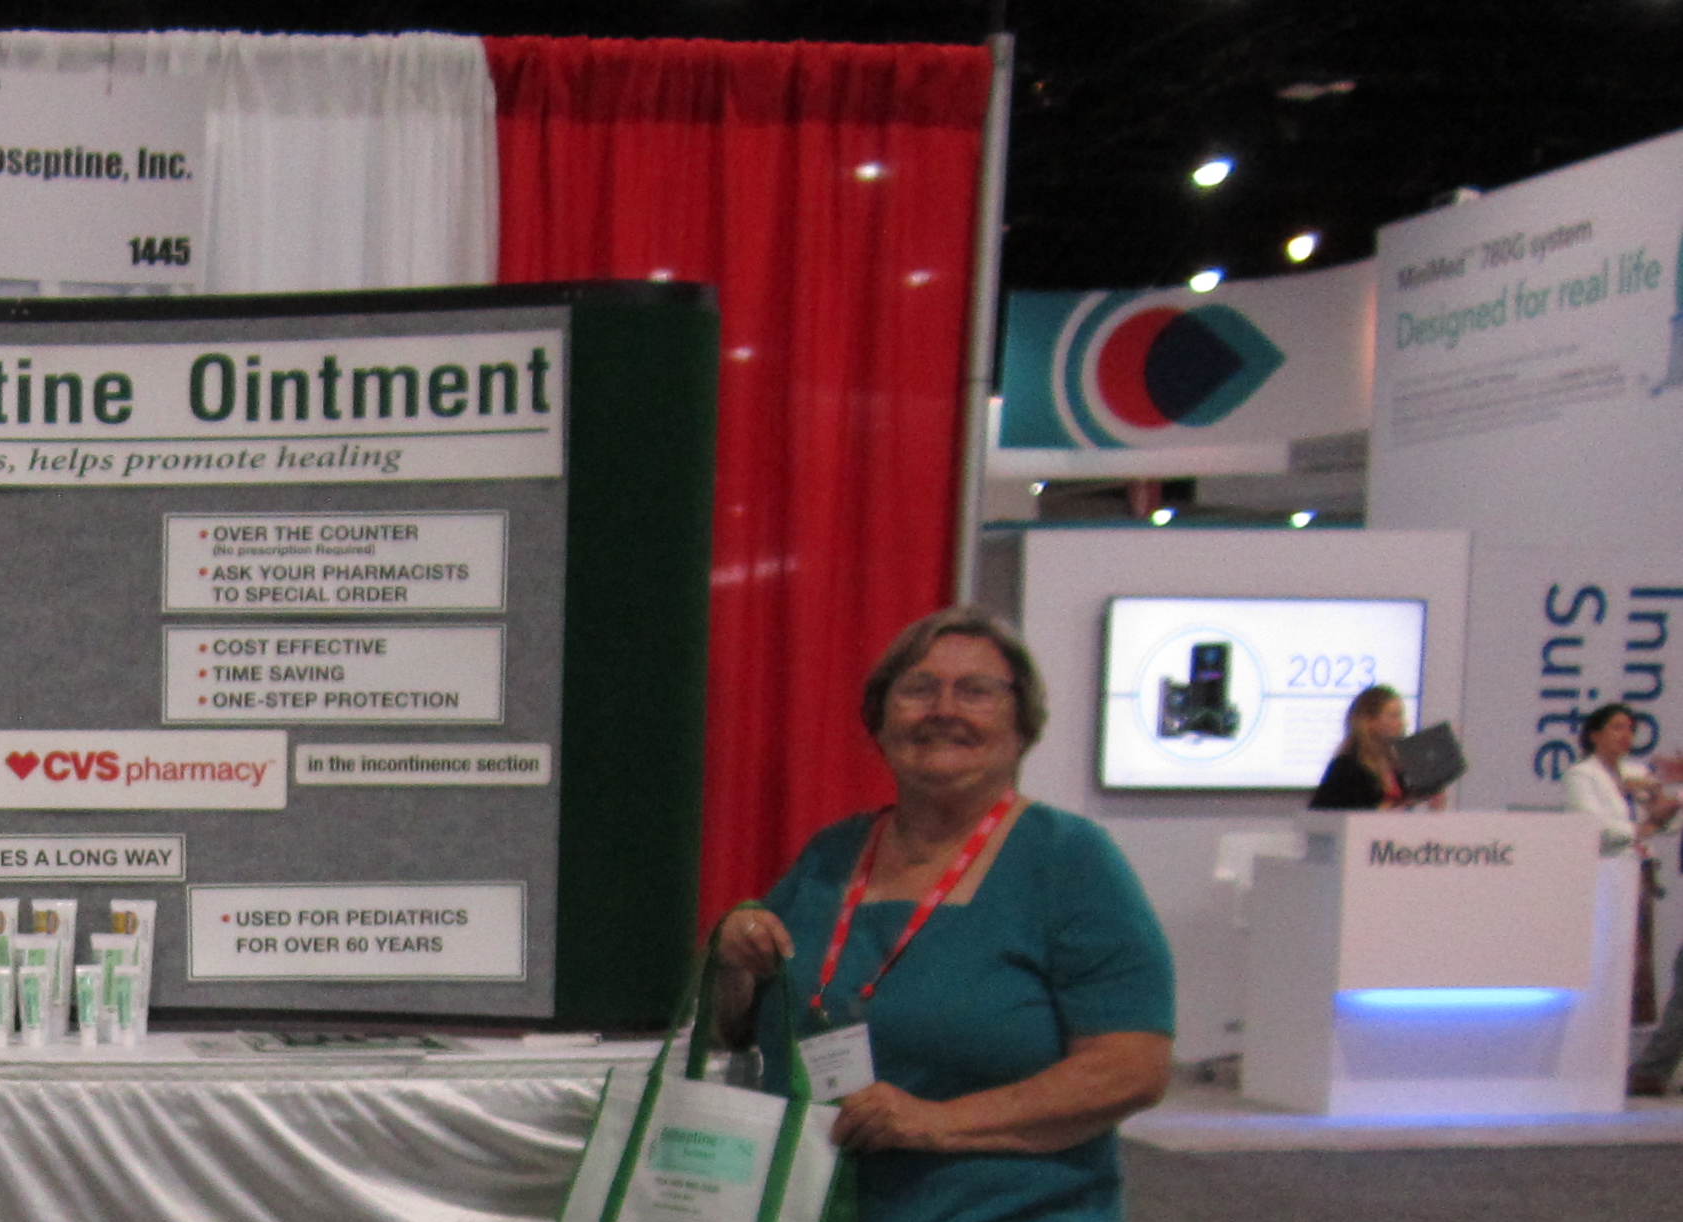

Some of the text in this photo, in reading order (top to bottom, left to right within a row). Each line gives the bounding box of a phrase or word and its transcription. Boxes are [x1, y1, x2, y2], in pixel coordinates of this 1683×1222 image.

[137, 146, 193, 181] Inc.
[128, 235, 192, 267] 1445
[1397, 246, 1663, 351] Designed for real life
[189, 345, 551, 421] Ointment
[28, 448, 115, 478] helps
[122, 446, 268, 477] promote
[276, 442, 403, 474] healing
[212, 523, 419, 542] OVER THE COUNTER
[211, 563, 470, 582] ASK YOUR PHARMACISTS
[212, 585, 408, 603] TO SPECIAL ORDER
[212, 638, 386, 656] COST EFFECTIVE
[212, 664, 345, 682] TIME SAVING
[1287, 655, 1377, 687] 2023
[1533, 583, 1608, 781] Suite
[212, 691, 459, 709] ONE-STEP PROTECTION
[42, 750, 120, 780] CVS
[124, 757, 268, 789] pharmacy
[307, 753, 540, 773] in the incontinence section
[33, 849, 50, 867] A
[55, 848, 118, 867] LONG
[123, 848, 173, 867] WAY
[1369, 838, 1513, 867] Medtronic
[235, 908, 468, 927] USED FOR PEDIATRICS
[235, 935, 443, 954] FOR OVER 60 YEARS
